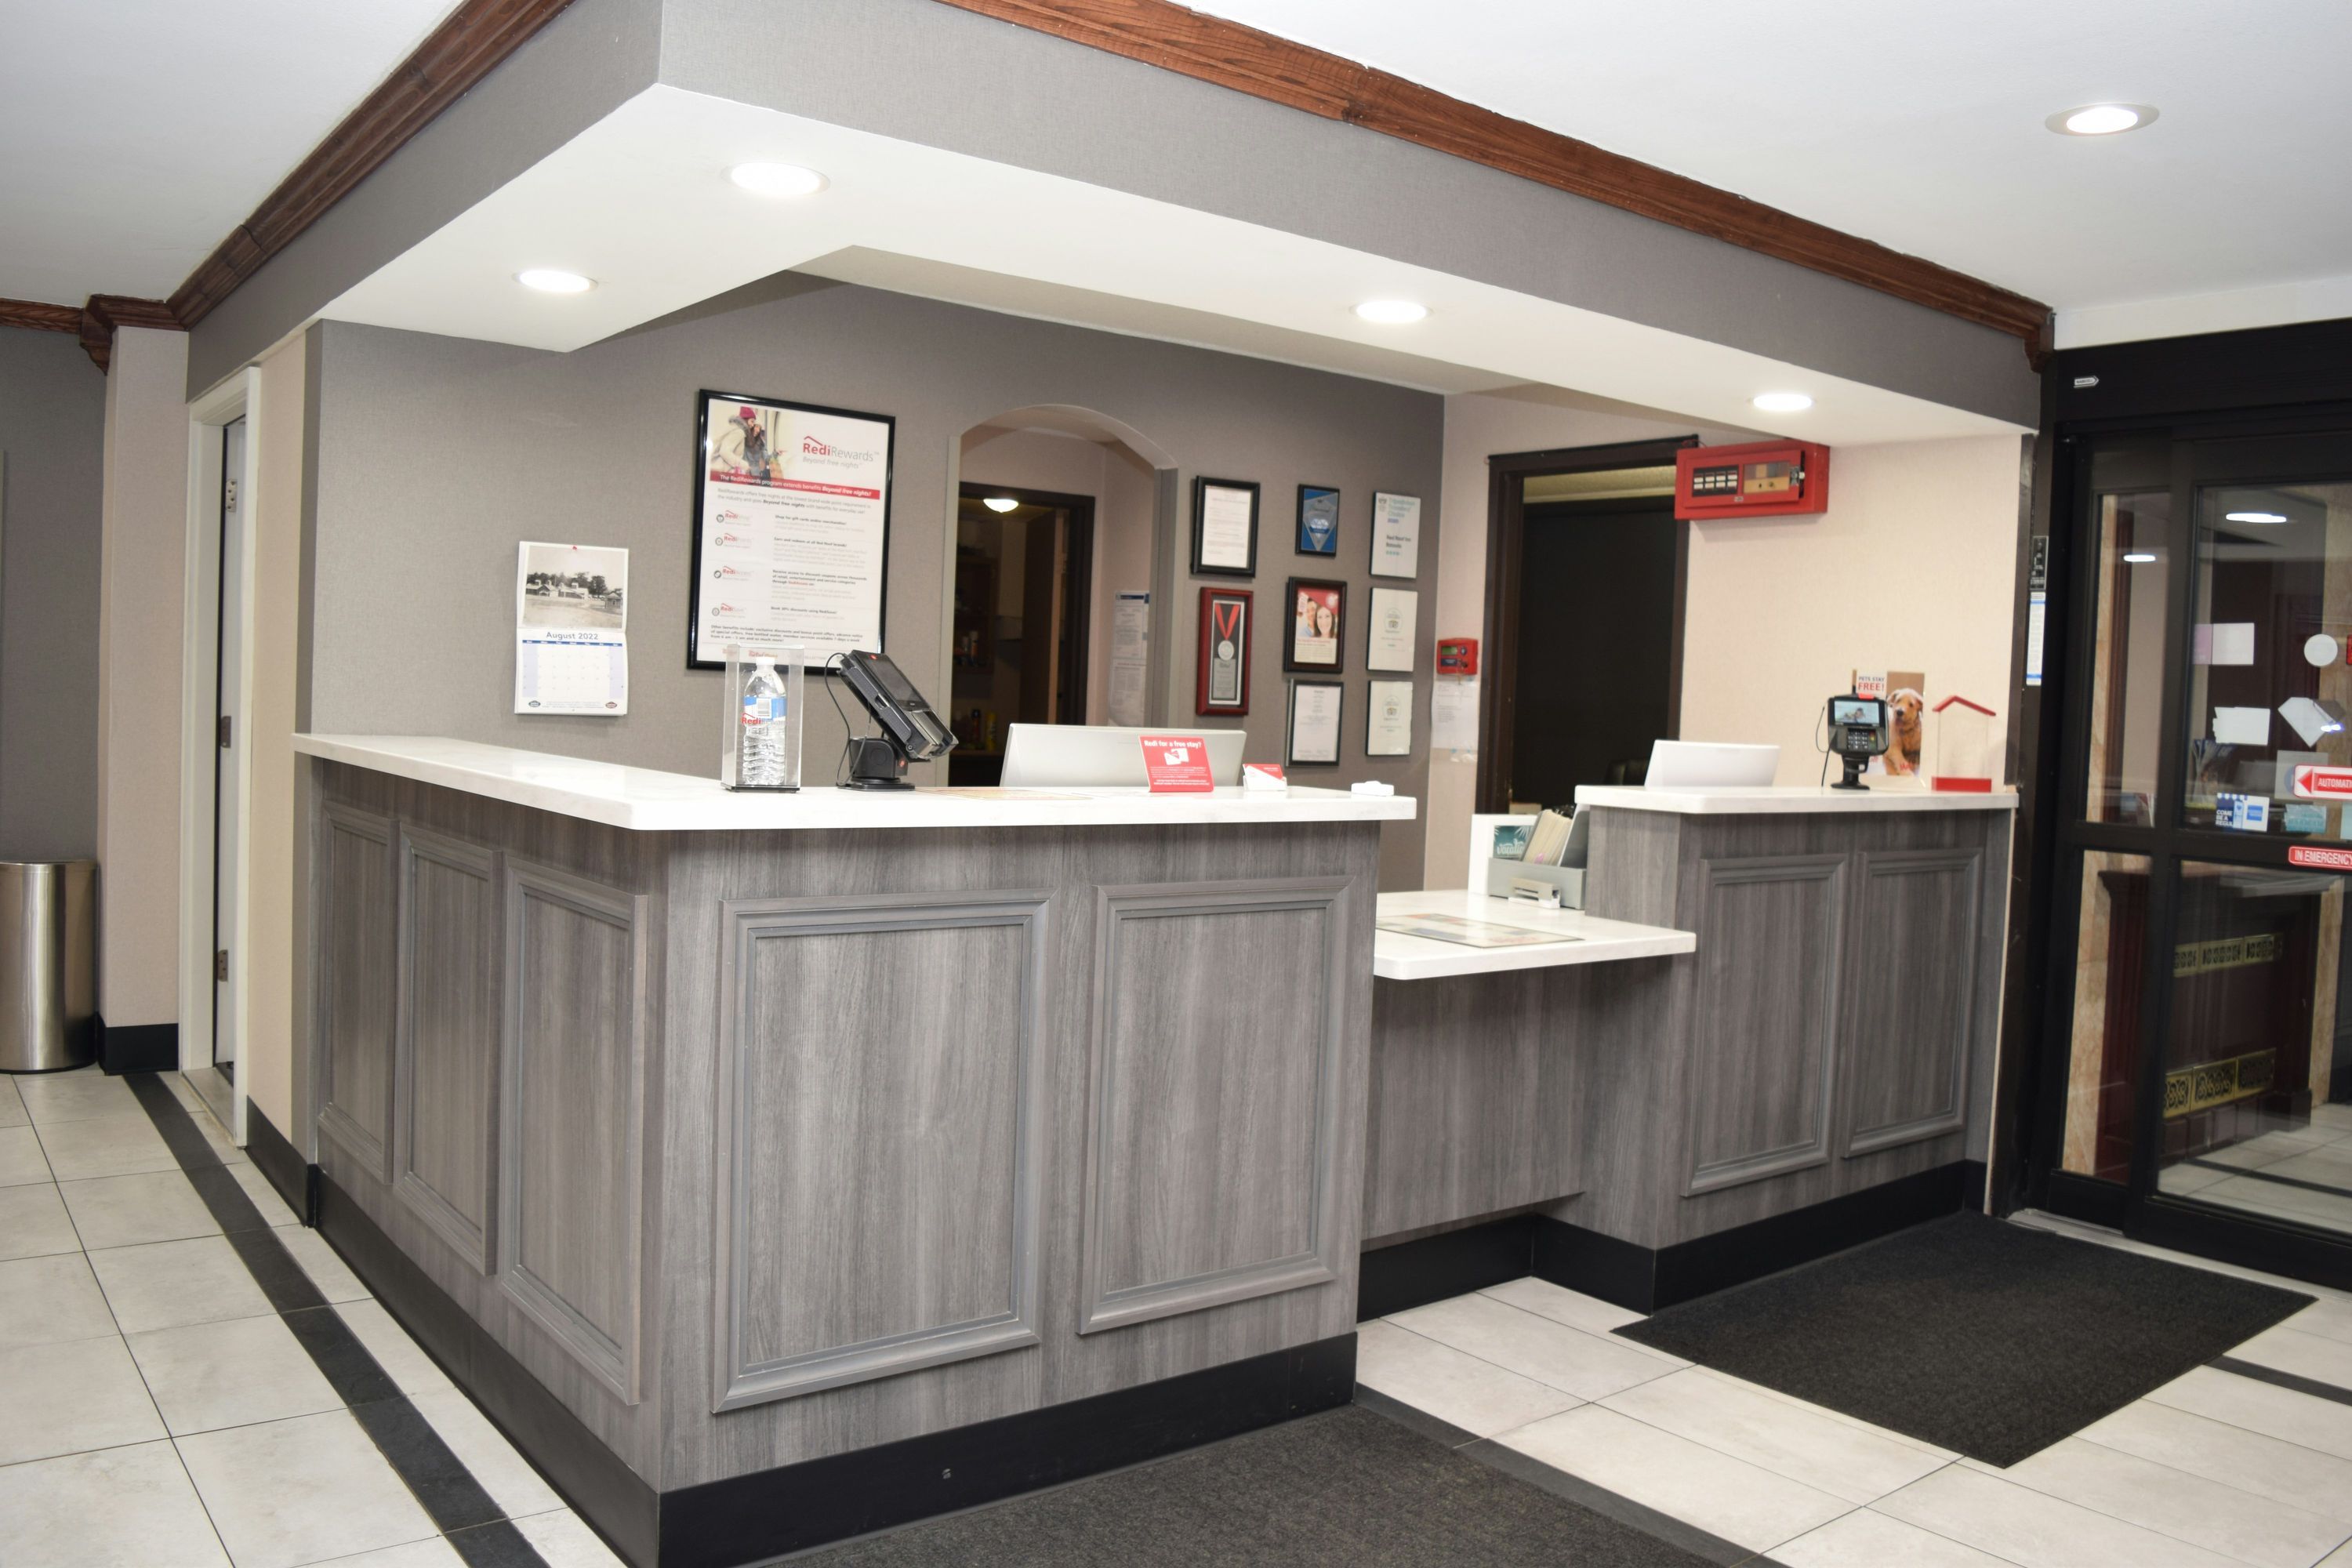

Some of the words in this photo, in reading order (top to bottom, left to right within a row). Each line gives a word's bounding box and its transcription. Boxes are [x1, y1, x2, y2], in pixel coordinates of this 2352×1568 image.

[802, 456, 826, 465] Beyond
[840, 461, 859, 470] nights
[730, 476, 761, 485] RediRewards
[546, 631, 575, 641] August
[1857, 682, 1885, 692] FREE!
[1186, 741, 1202, 750] stay?
[1496, 838, 1526, 855] vacatio
[2295, 849, 2303, 861] IN
